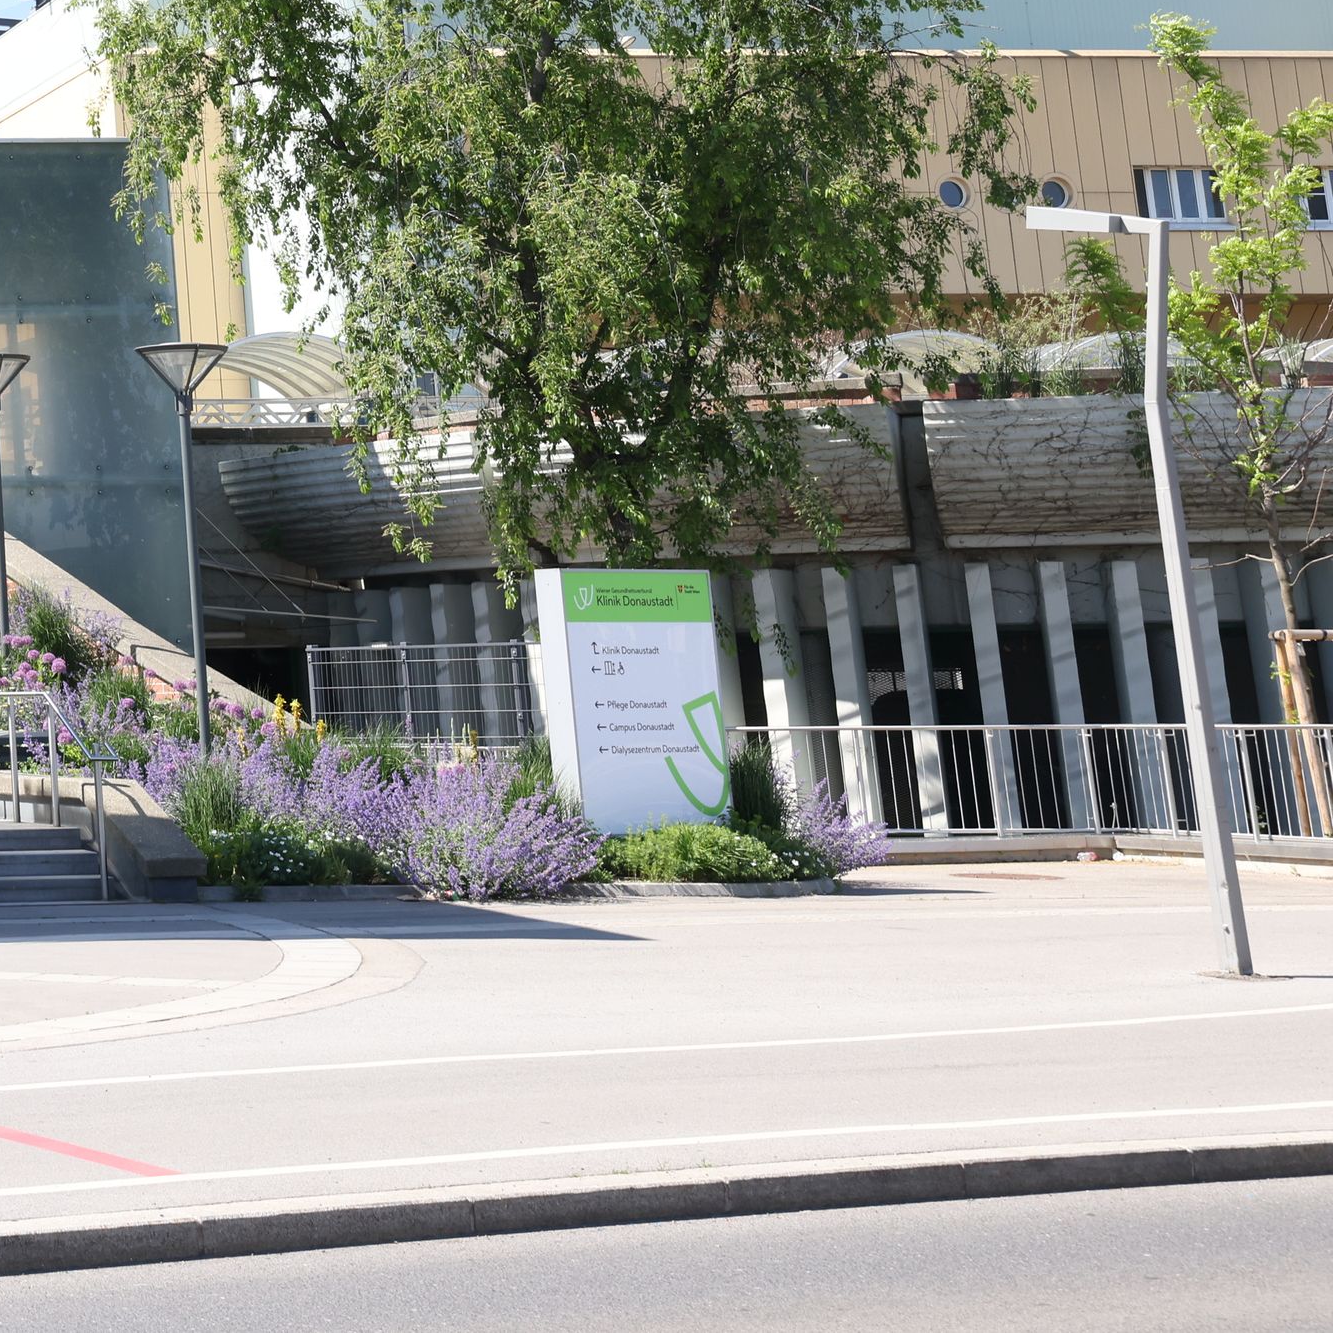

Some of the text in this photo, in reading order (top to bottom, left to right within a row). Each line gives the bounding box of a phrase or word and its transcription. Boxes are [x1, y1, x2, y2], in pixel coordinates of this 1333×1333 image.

[596, 595, 674, 607] Klinik Donaustadt
[602, 646, 660, 655] Klinik Donaustadt
[607, 700, 668, 711] Pflege Donaustadt
[609, 722, 675, 733] Campus Donaustadt
[611, 744, 700, 756] Dialysezentrum Donaustadt
